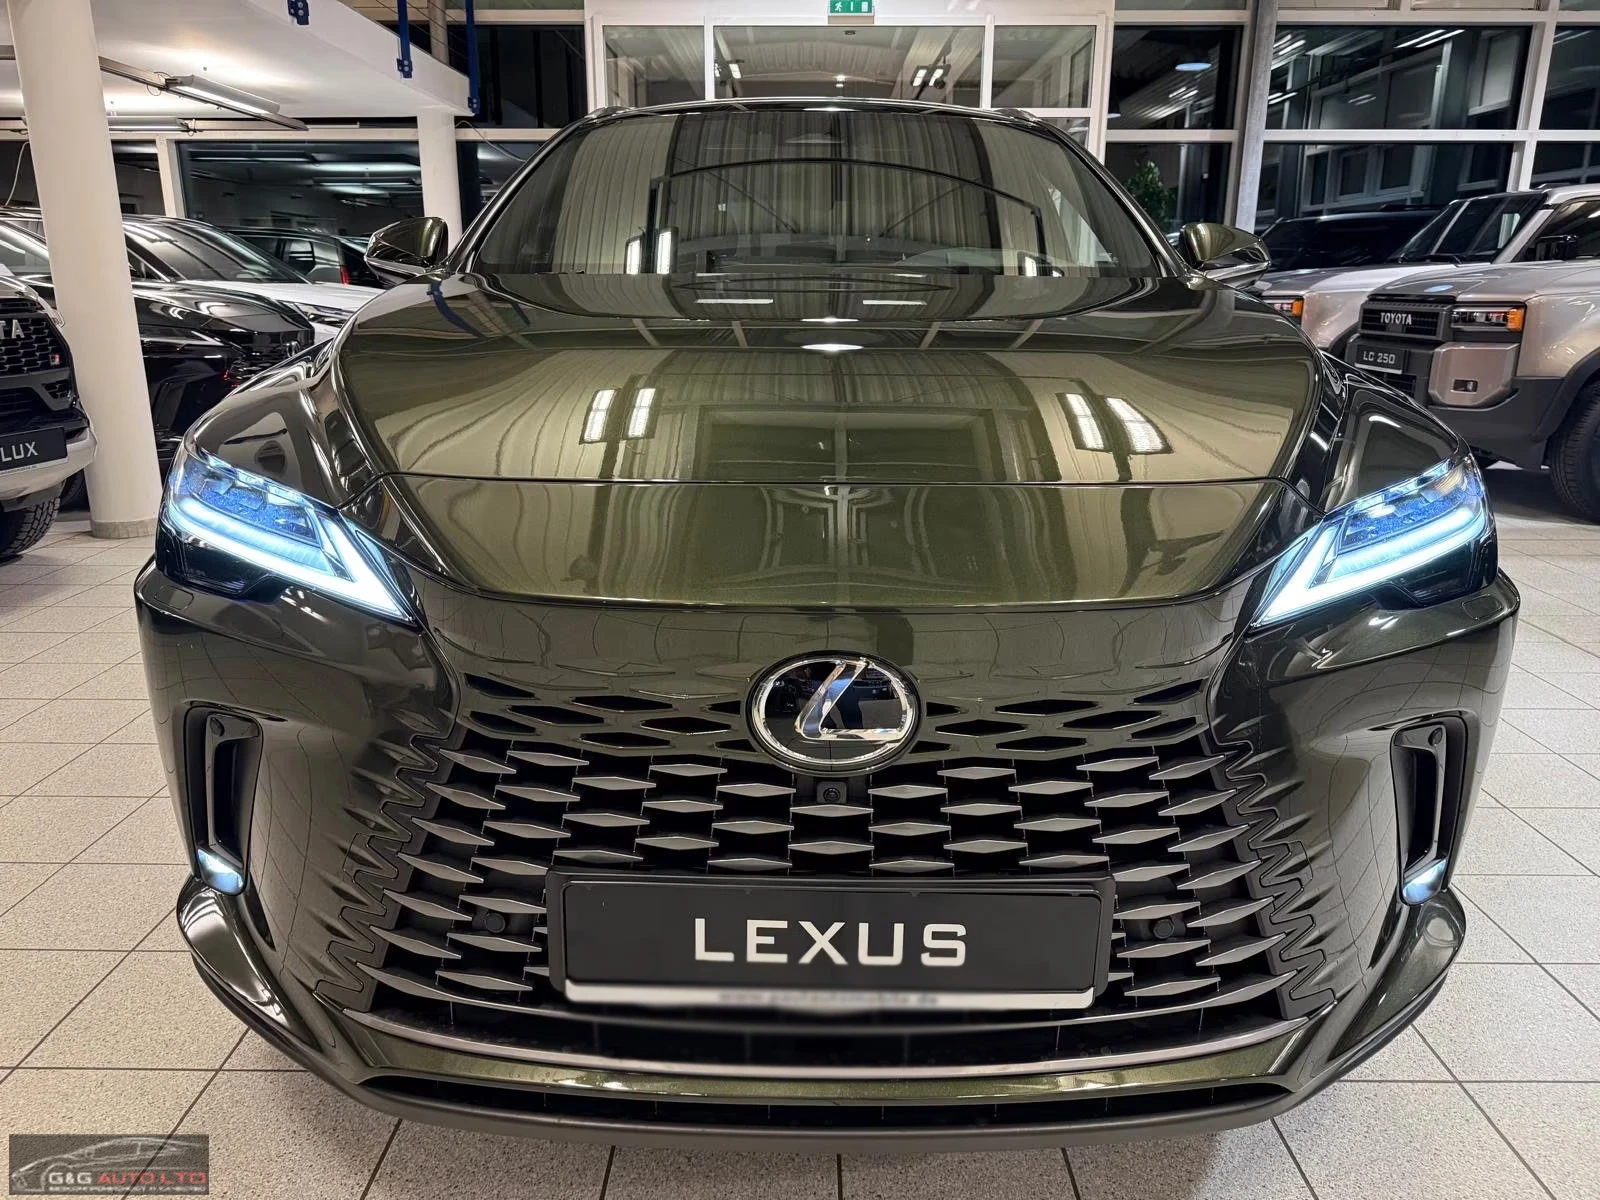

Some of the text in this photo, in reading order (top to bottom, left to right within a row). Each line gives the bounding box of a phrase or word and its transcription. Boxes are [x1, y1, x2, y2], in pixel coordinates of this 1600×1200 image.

[1380, 312, 1412, 325] TOYOTA
[1377, 352, 1395, 364] 250
[694, 918, 967, 967] LEXUS
